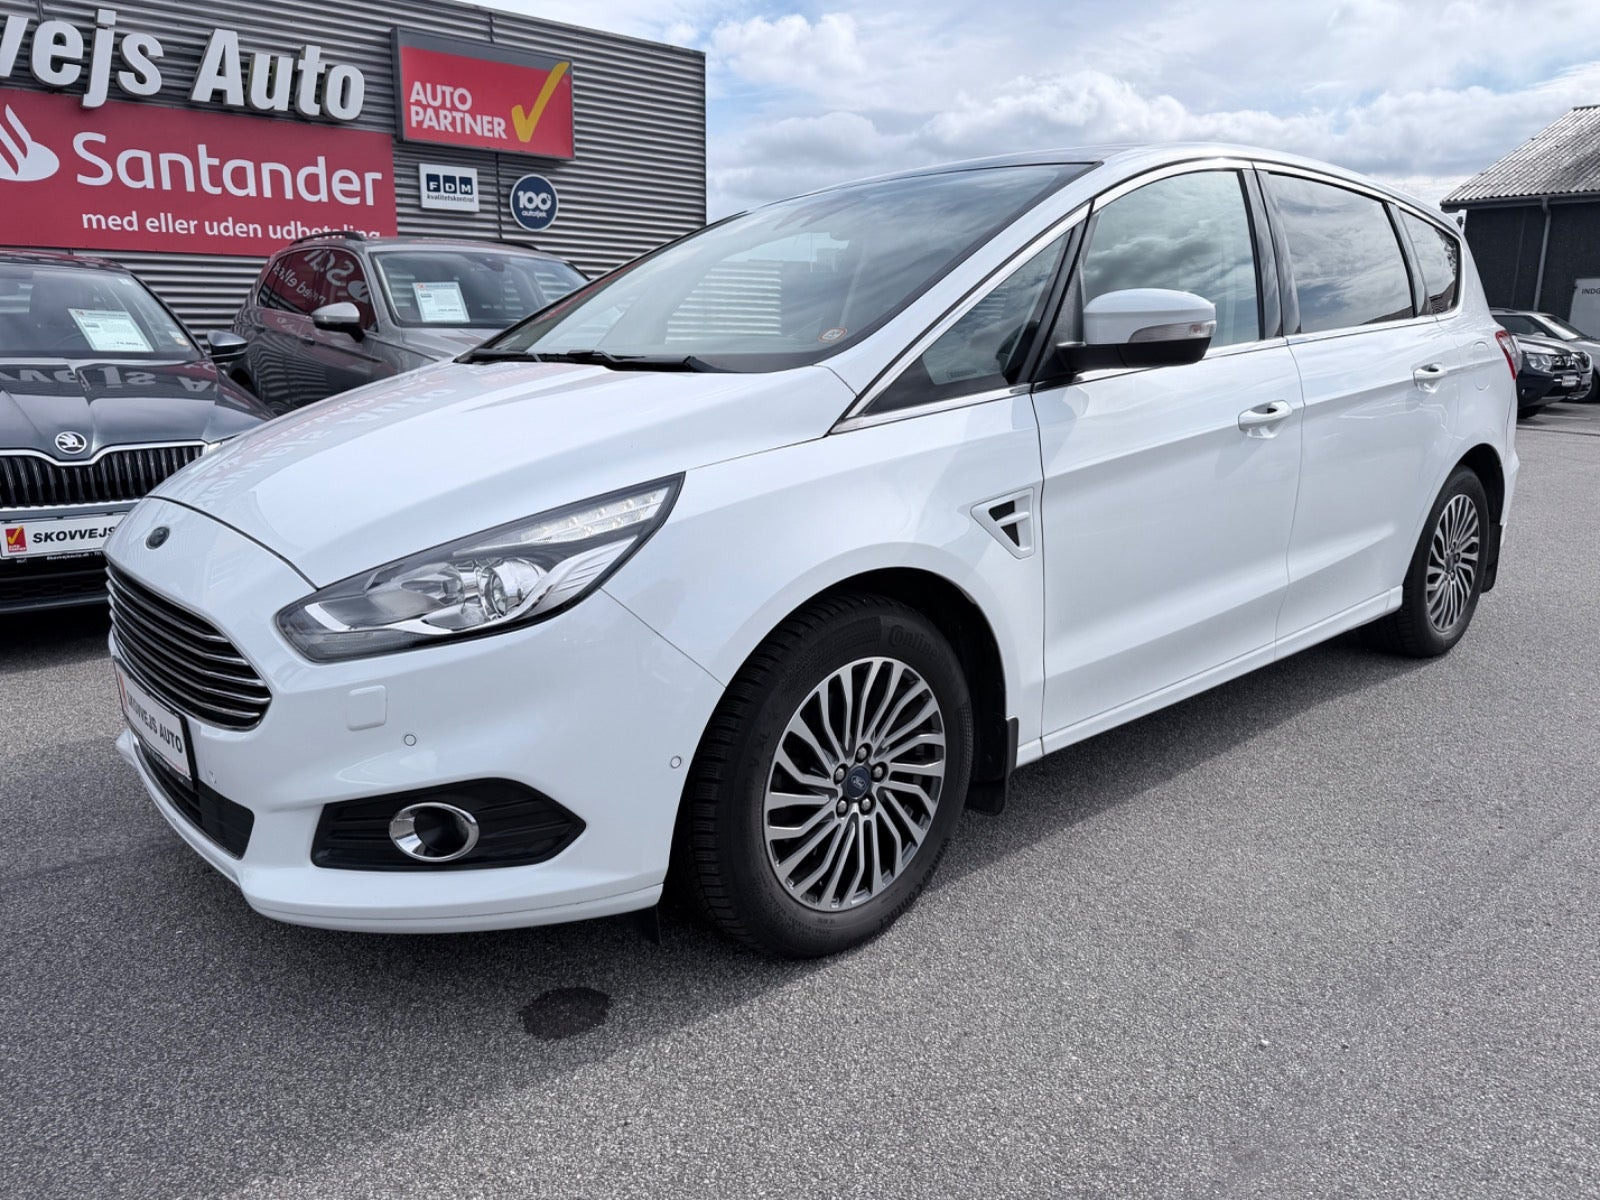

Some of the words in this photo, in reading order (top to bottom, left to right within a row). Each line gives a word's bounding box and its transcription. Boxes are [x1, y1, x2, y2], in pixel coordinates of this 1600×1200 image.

[190, 28, 366, 121] Auto
[409, 81, 472, 111] AUTO
[410, 105, 508, 139] PARTNER
[72, 131, 383, 206] Santander
[427, 193, 475, 204] kvalitetskontrol
[428, 180, 473, 194] FDM
[82, 211, 139, 231] med
[145, 212, 198, 234] eller
[204, 216, 262, 238] uden
[160, 723, 183, 754] AUTO
